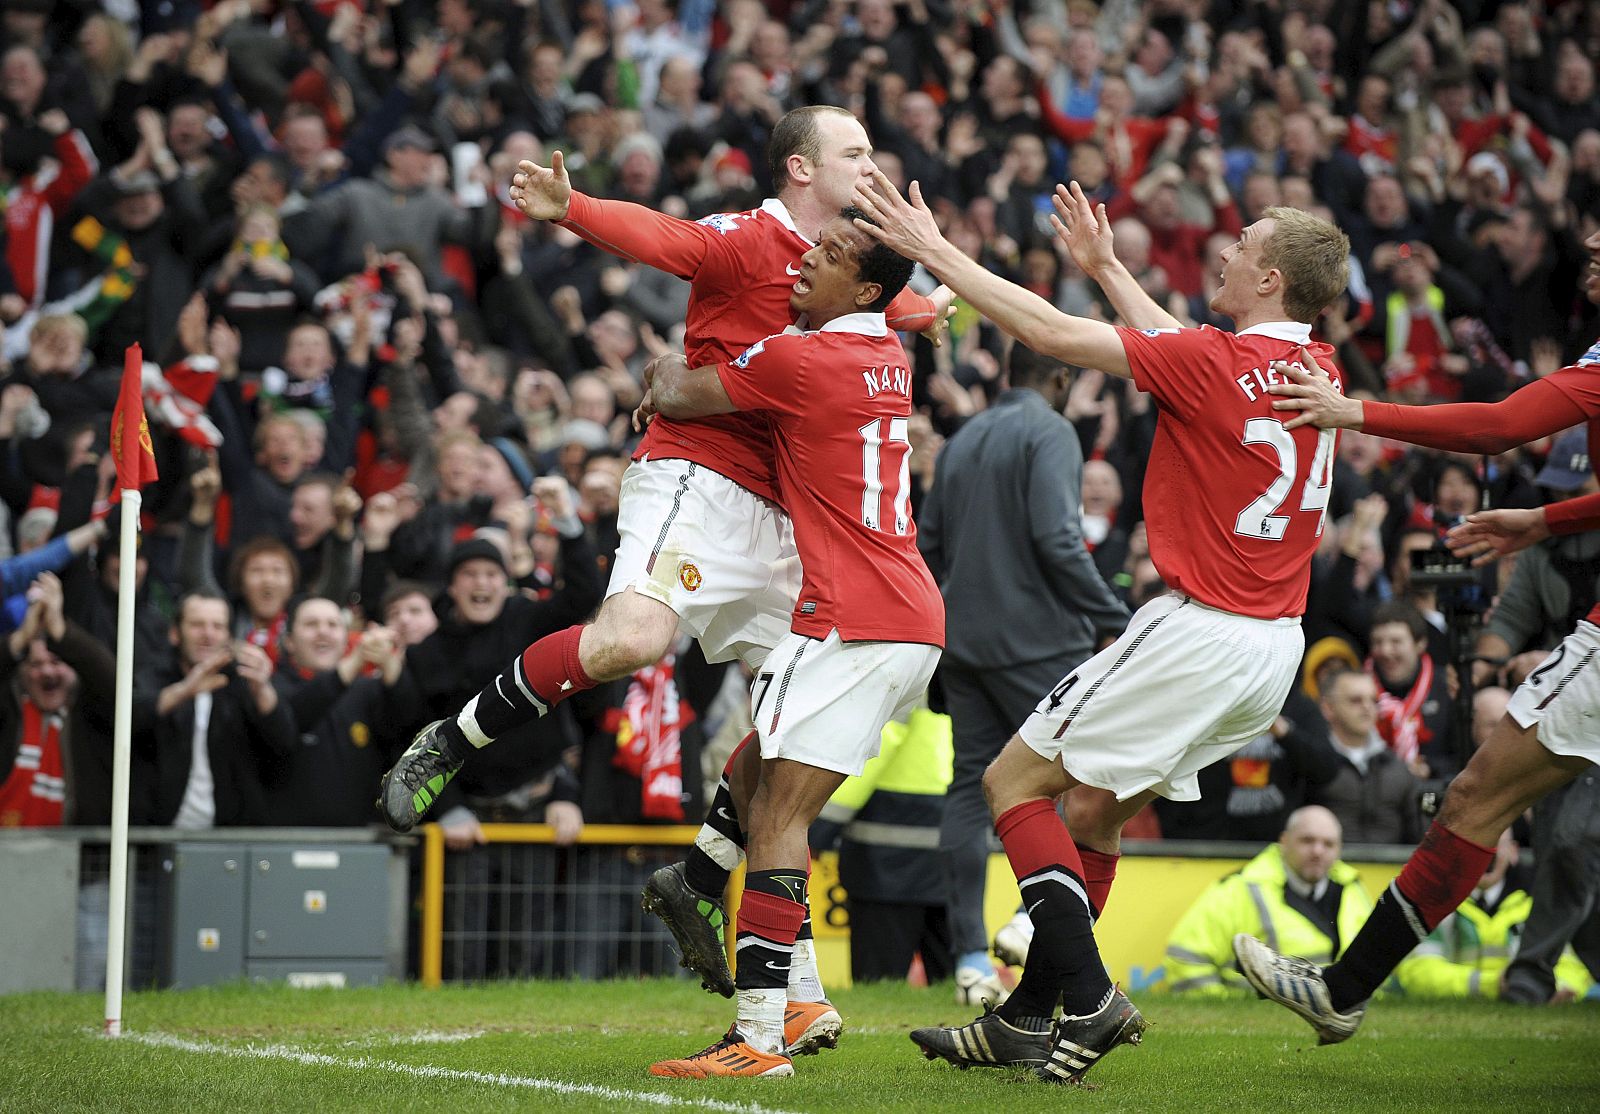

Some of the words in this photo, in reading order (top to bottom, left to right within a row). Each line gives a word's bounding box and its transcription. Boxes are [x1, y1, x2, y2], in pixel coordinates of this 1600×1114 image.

[863, 365, 911, 397] NANI
[858, 416, 913, 536] 17
[1234, 416, 1337, 541] 24
[751, 672, 775, 723] 7
